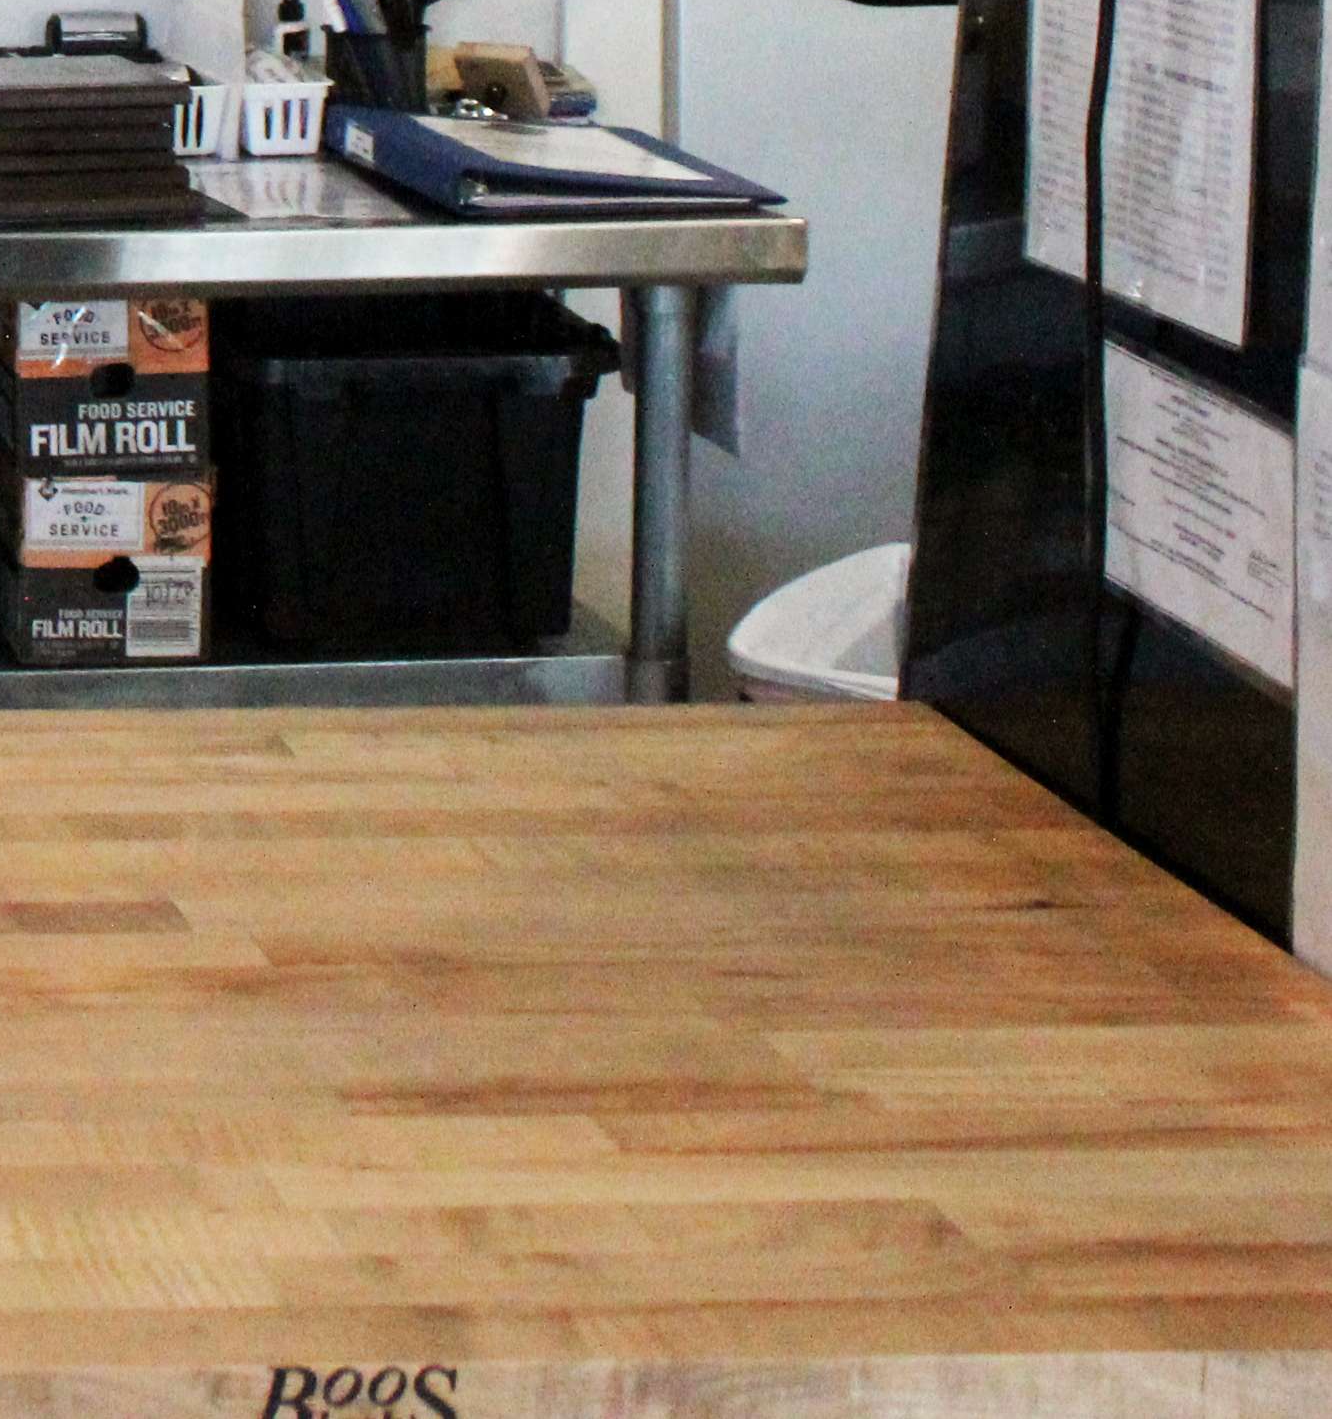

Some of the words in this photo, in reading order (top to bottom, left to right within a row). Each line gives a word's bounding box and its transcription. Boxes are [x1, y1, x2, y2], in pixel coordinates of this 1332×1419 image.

[78, 403, 121, 419] FOOD
[126, 400, 196, 418] SERVICE
[30, 423, 107, 457] FILM
[114, 419, 197, 454] ROLL
[63, 501, 106, 516] FOOD
[49, 524, 119, 537] SERVICE
[32, 618, 75, 639] FILM
[79, 617, 124, 638] ROLL
